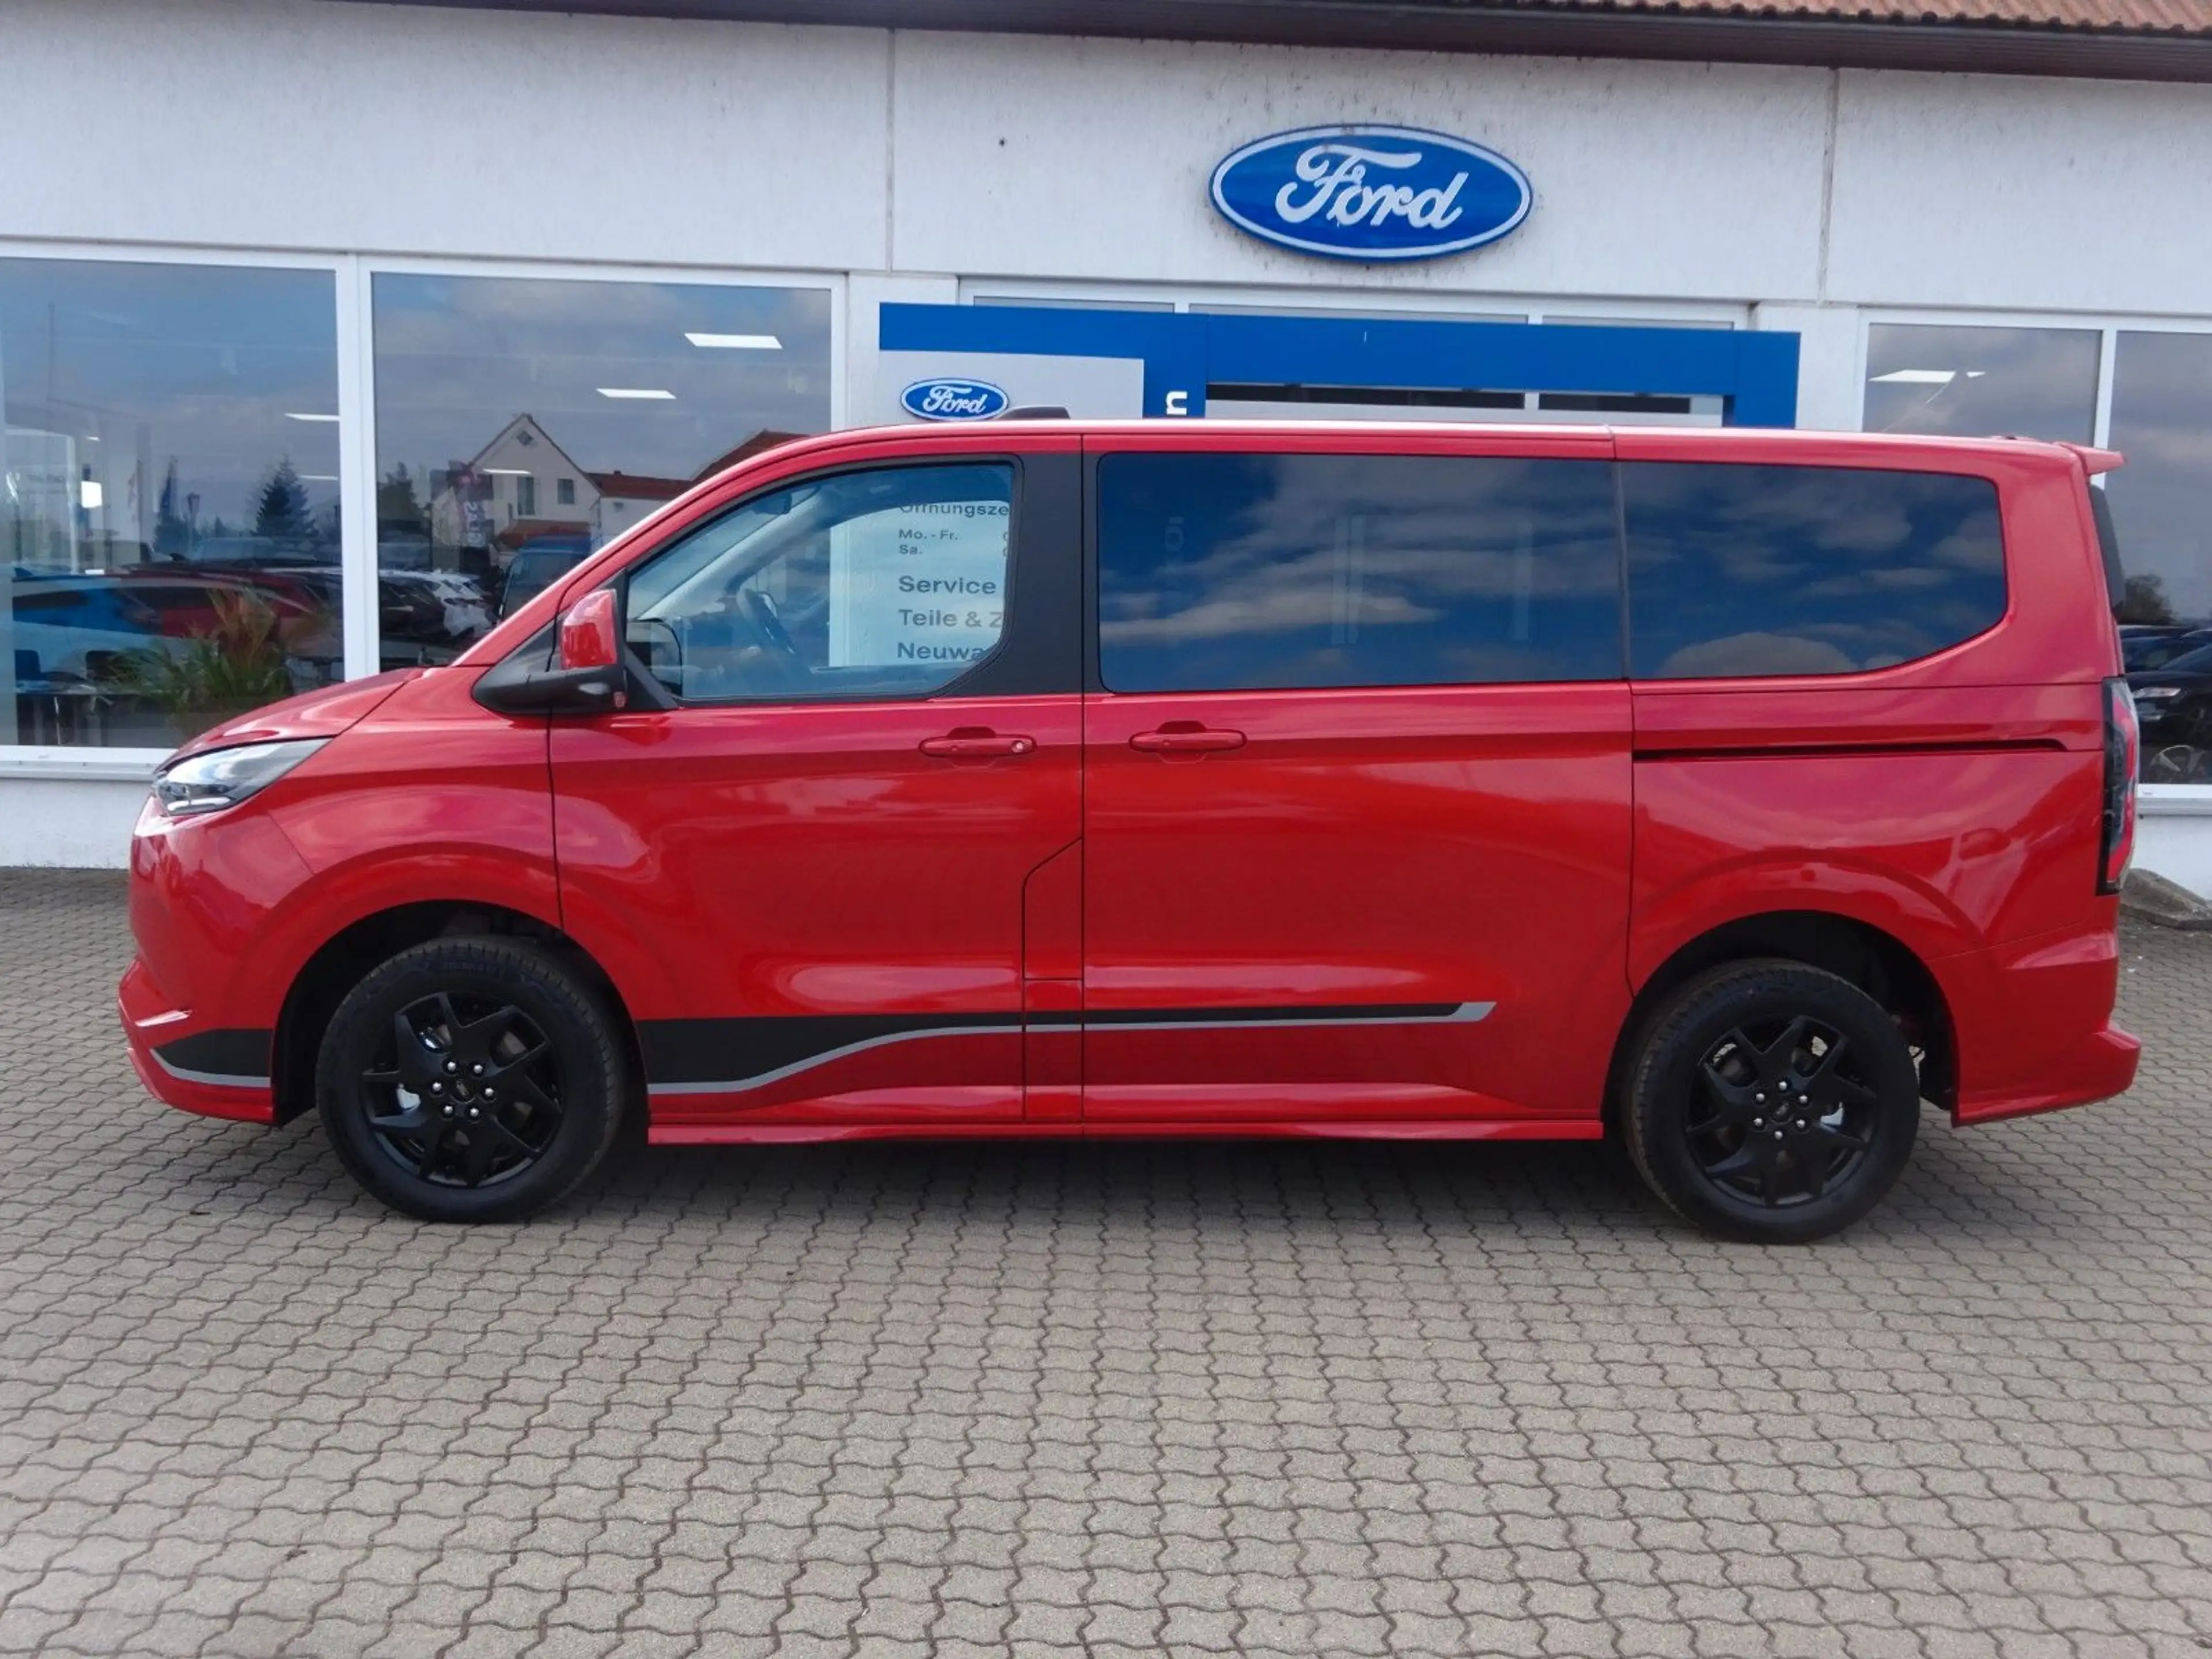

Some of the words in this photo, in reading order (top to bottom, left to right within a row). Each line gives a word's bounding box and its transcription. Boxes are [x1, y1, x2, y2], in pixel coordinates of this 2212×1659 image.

[1275, 145, 1469, 229] Ford
[923, 385, 988, 414] Ford
[899, 529, 927, 539] Mo.
[940, 529, 958, 540] Fr.
[899, 575, 997, 594] Service
[899, 609, 957, 627] Teile
[965, 611, 983, 628] &
